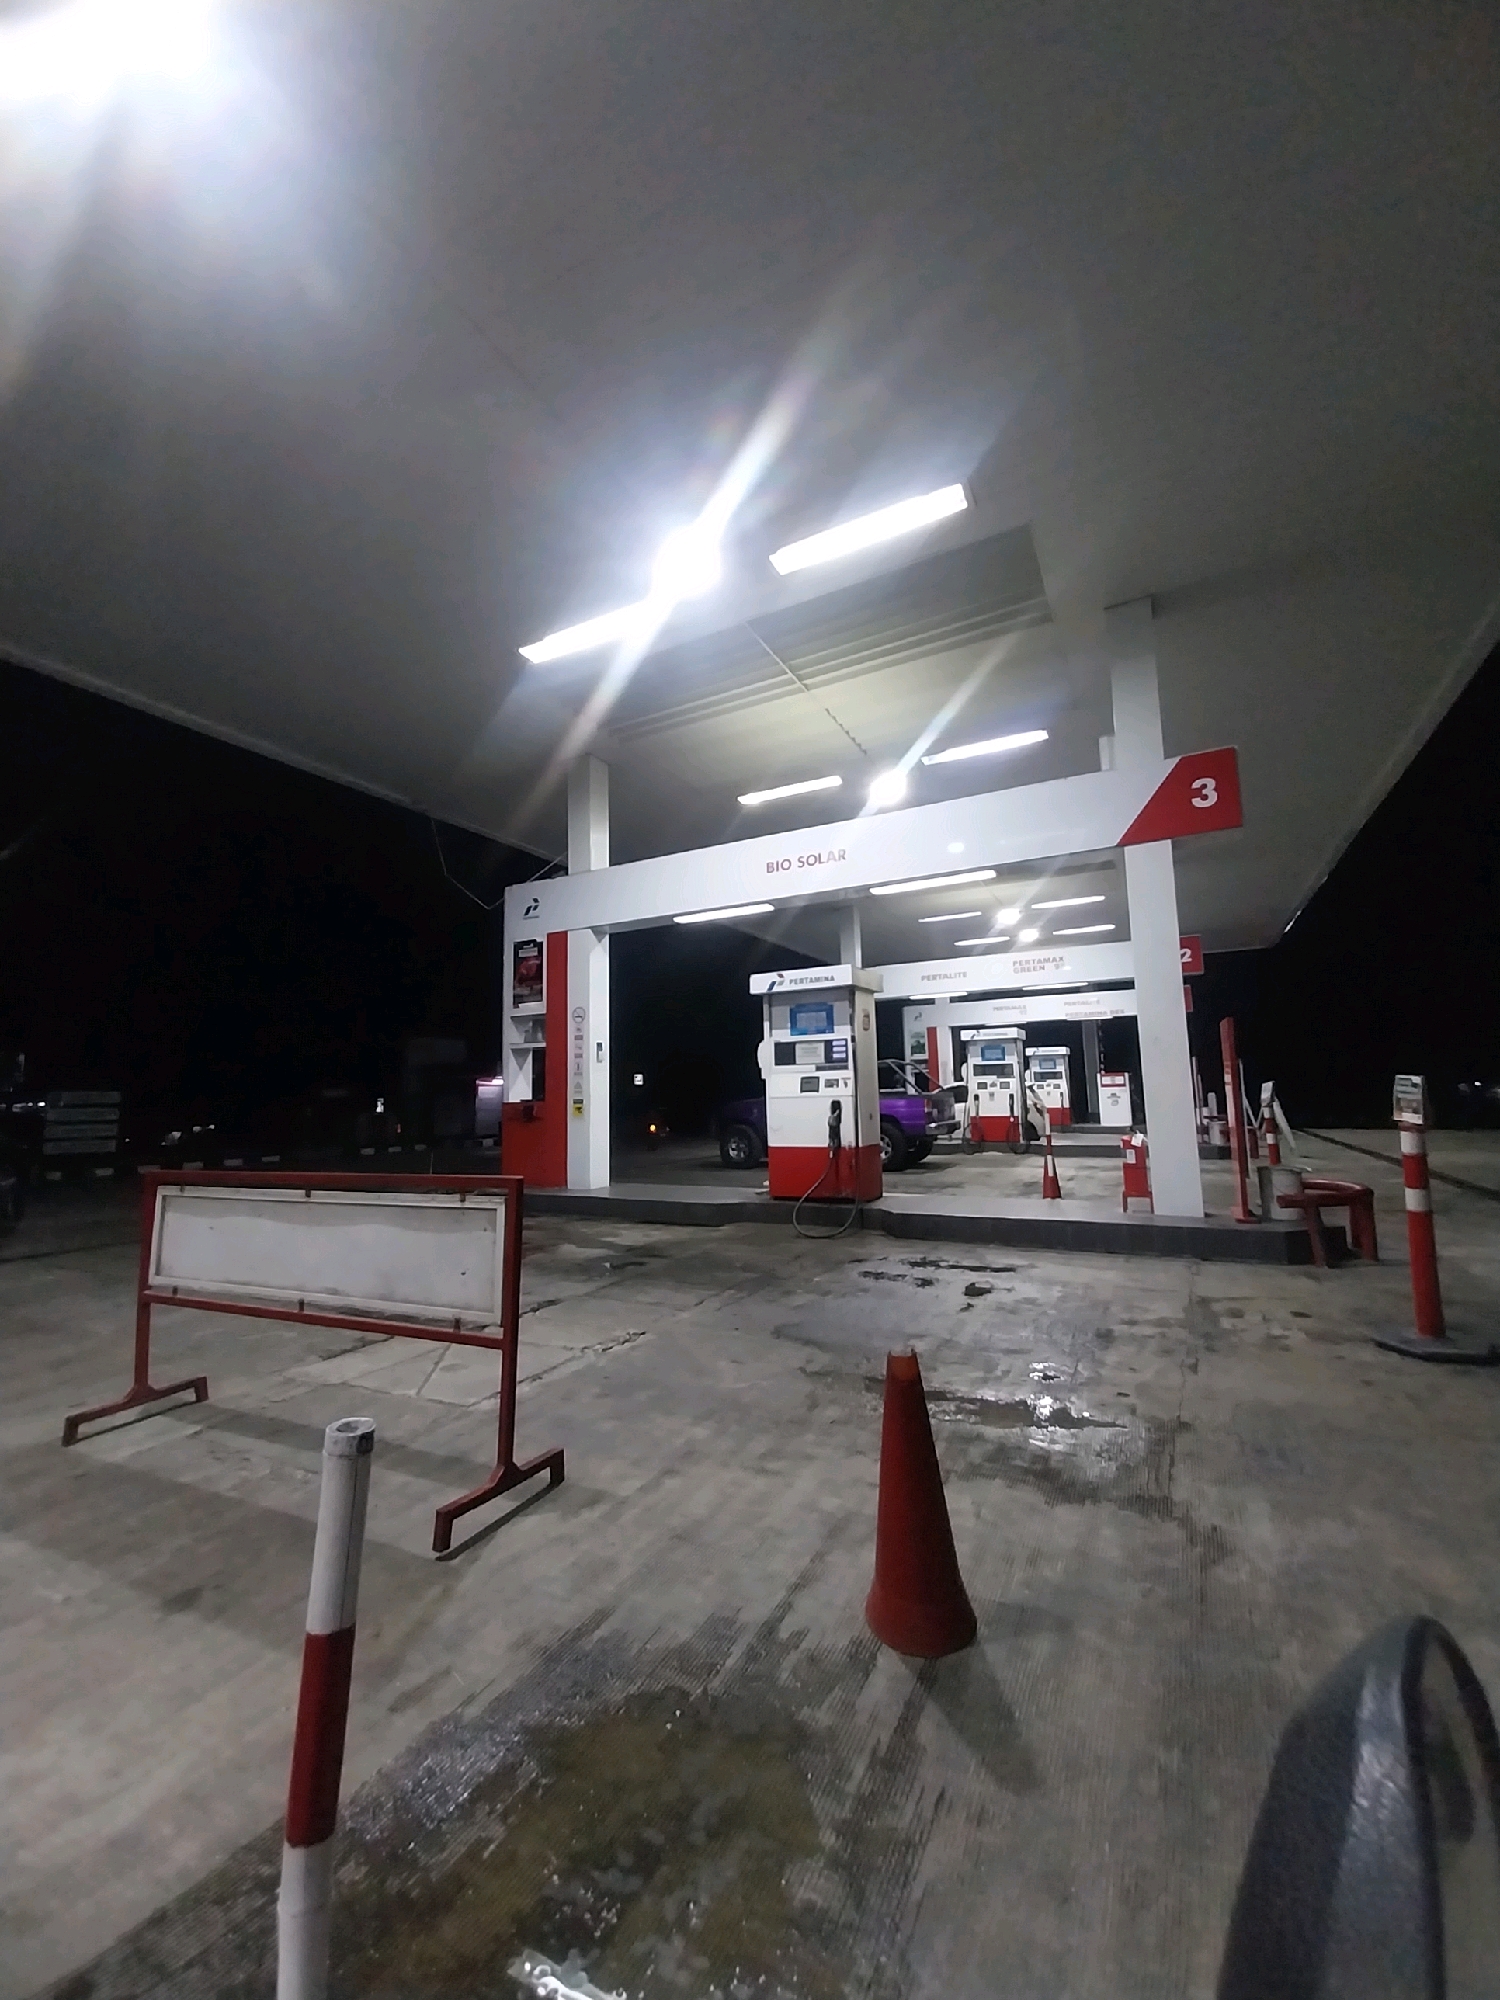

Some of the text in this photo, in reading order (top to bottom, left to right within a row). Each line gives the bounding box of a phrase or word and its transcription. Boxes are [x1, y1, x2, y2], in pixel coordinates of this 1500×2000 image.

[1191, 777, 1218, 808] 3
[766, 849, 846, 873] BIO SOLAR
[1180, 948, 1192, 962] 2
[1012, 956, 1064, 968] PERTAMAX
[1013, 964, 1045, 974] GREEN
[789, 975, 835, 985] PERTAMINA
[921, 972, 967, 981] PERTALITE
